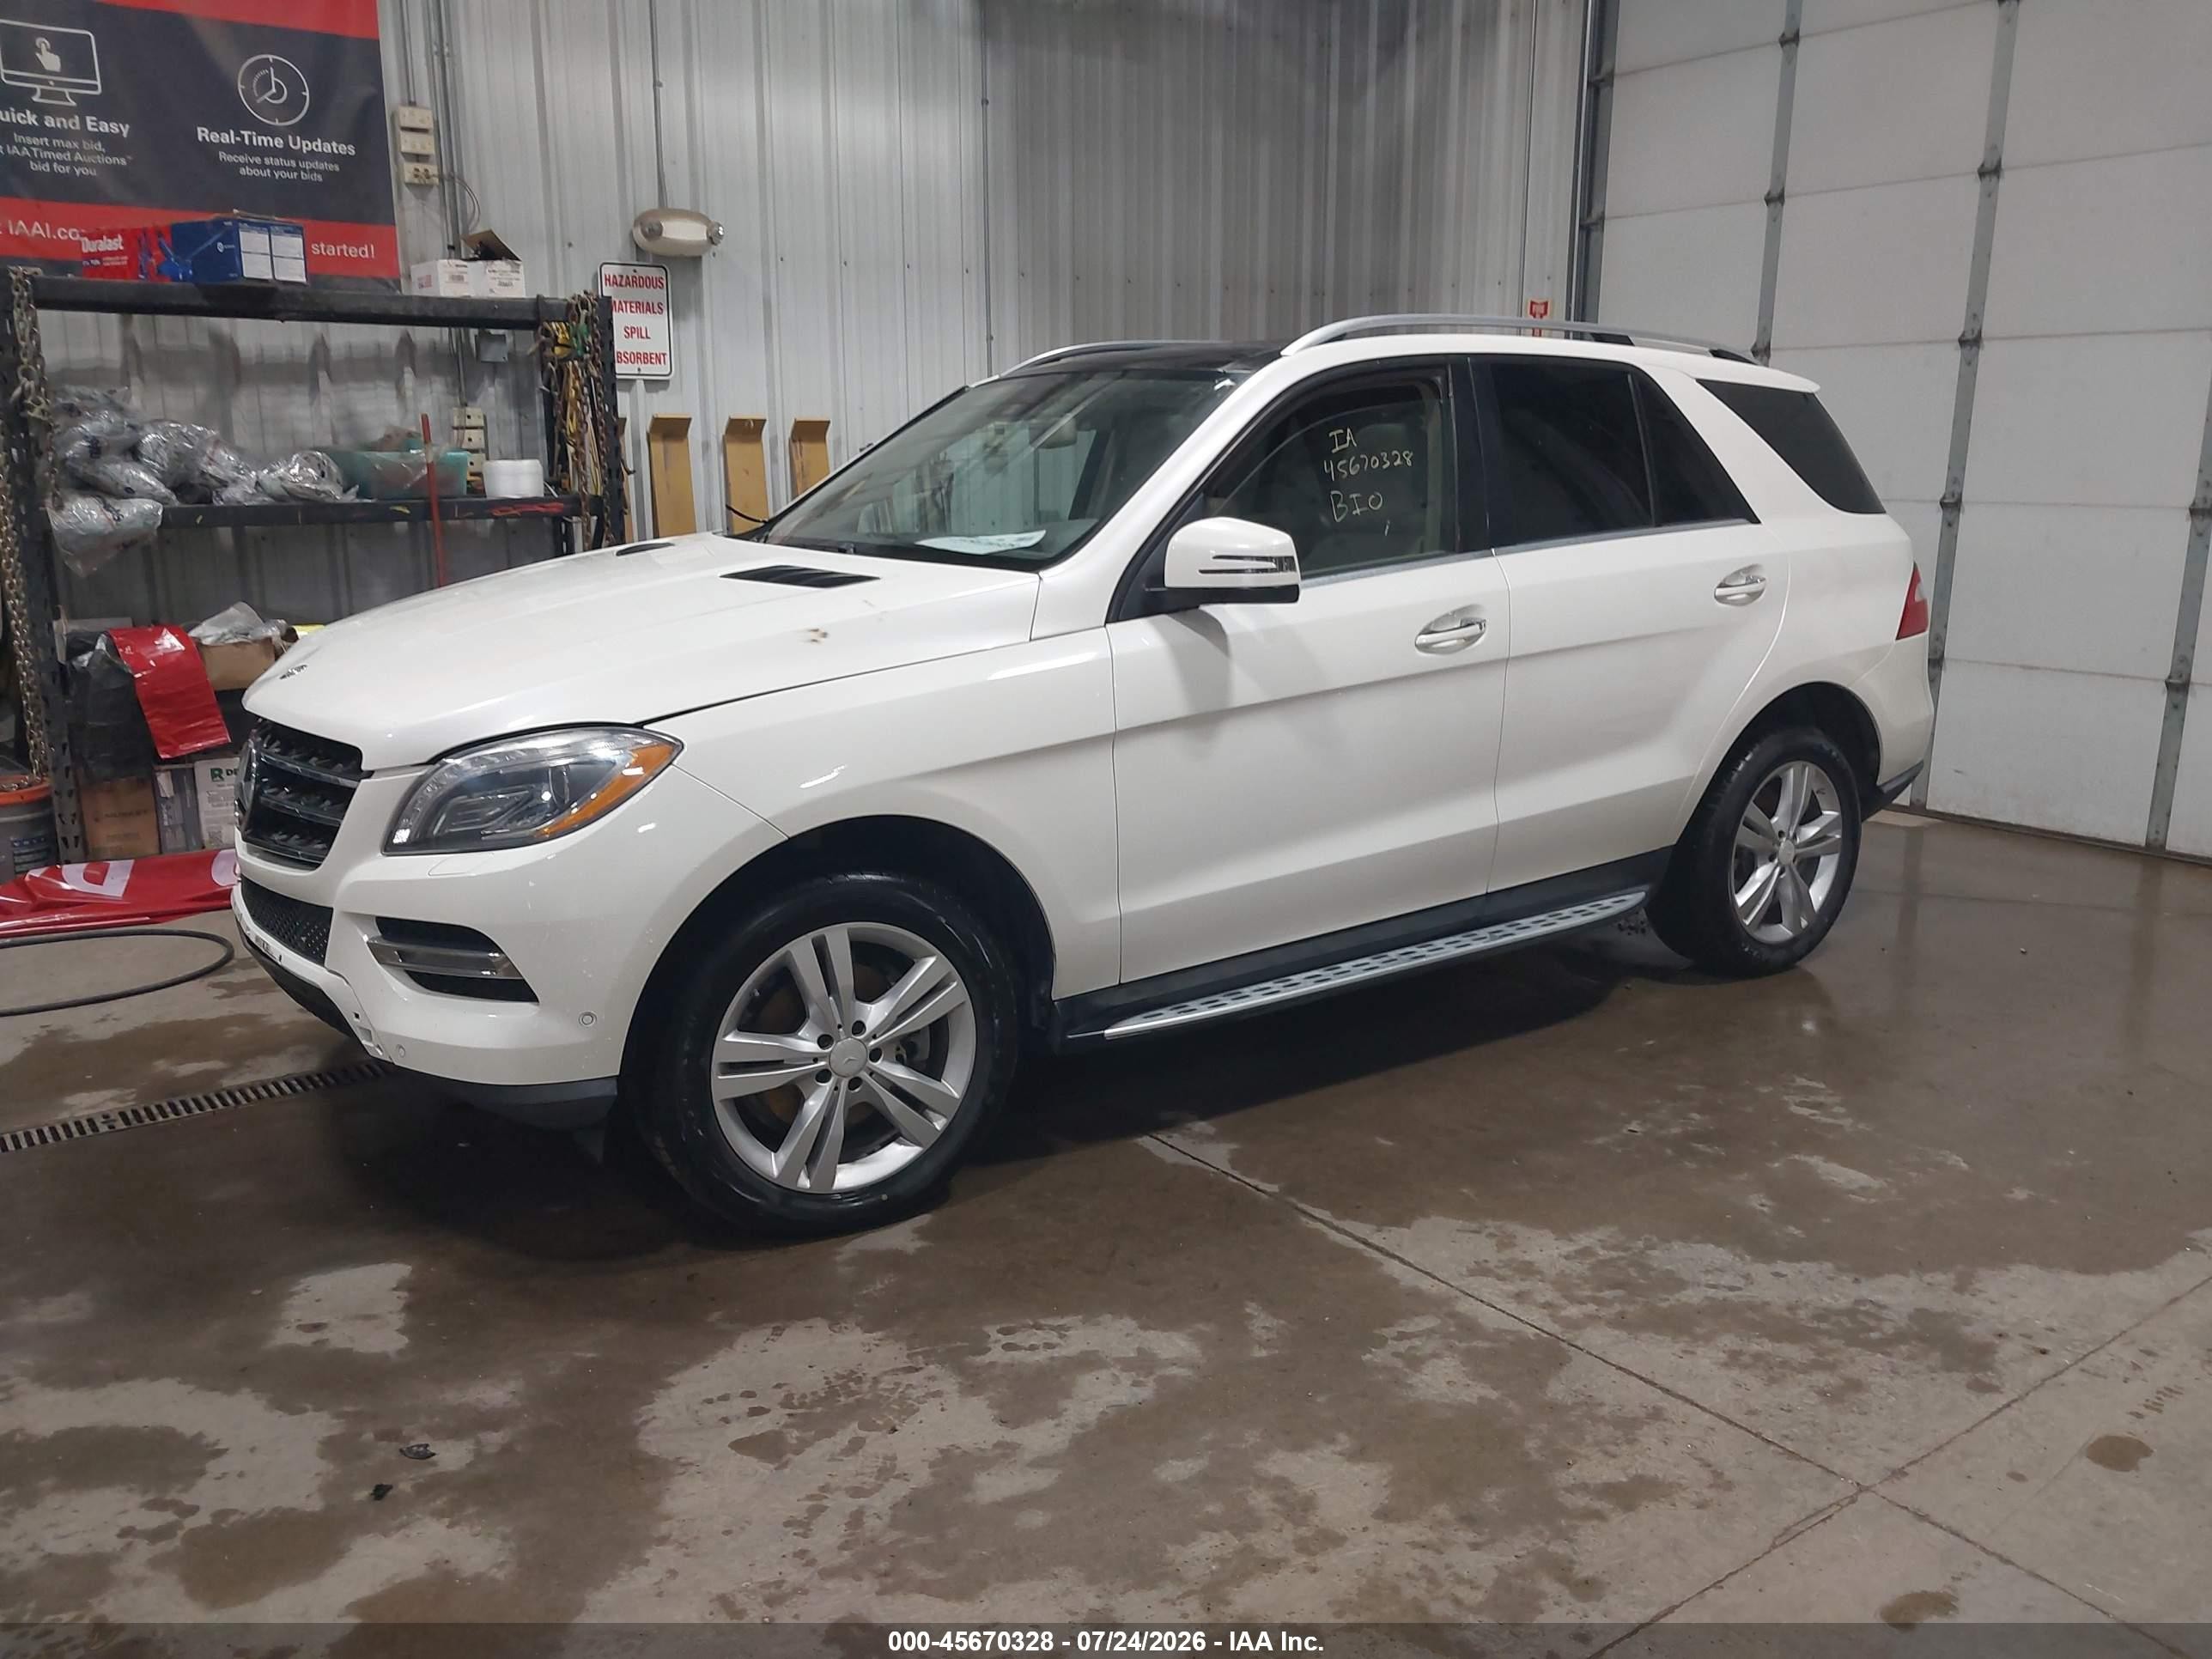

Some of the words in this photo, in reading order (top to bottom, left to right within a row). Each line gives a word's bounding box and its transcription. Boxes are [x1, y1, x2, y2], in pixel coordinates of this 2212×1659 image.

[0, 107, 39, 126] uick
[44, 114, 81, 131] and
[86, 116, 130, 138] Easy
[14, 132, 49, 147] Insert
[52, 138, 79, 150] max
[82, 139, 106, 153] bid,
[197, 126, 284, 149] Real-Time
[289, 134, 356, 156] Updates
[29, 160, 50, 173] bid
[53, 161, 70, 174] for
[73, 165, 97, 177] you
[218, 150, 262, 166] Receive
[264, 155, 296, 168] status
[299, 158, 340, 172] updates
[239, 166, 271, 178] about
[273, 169, 299, 180] your
[301, 171, 323, 182] bids
[8, 220, 82, 240] IAAI.co
[311, 242, 375, 259] started!
[604, 274, 665, 289] HAZARDOUS
[611, 299, 665, 315] MATERIALS
[623, 325, 651, 339] SPILL
[617, 350, 667, 365] BSORBENT
[1323, 450, 1413, 482] 45670328
[1330, 490, 1383, 523] BIO
